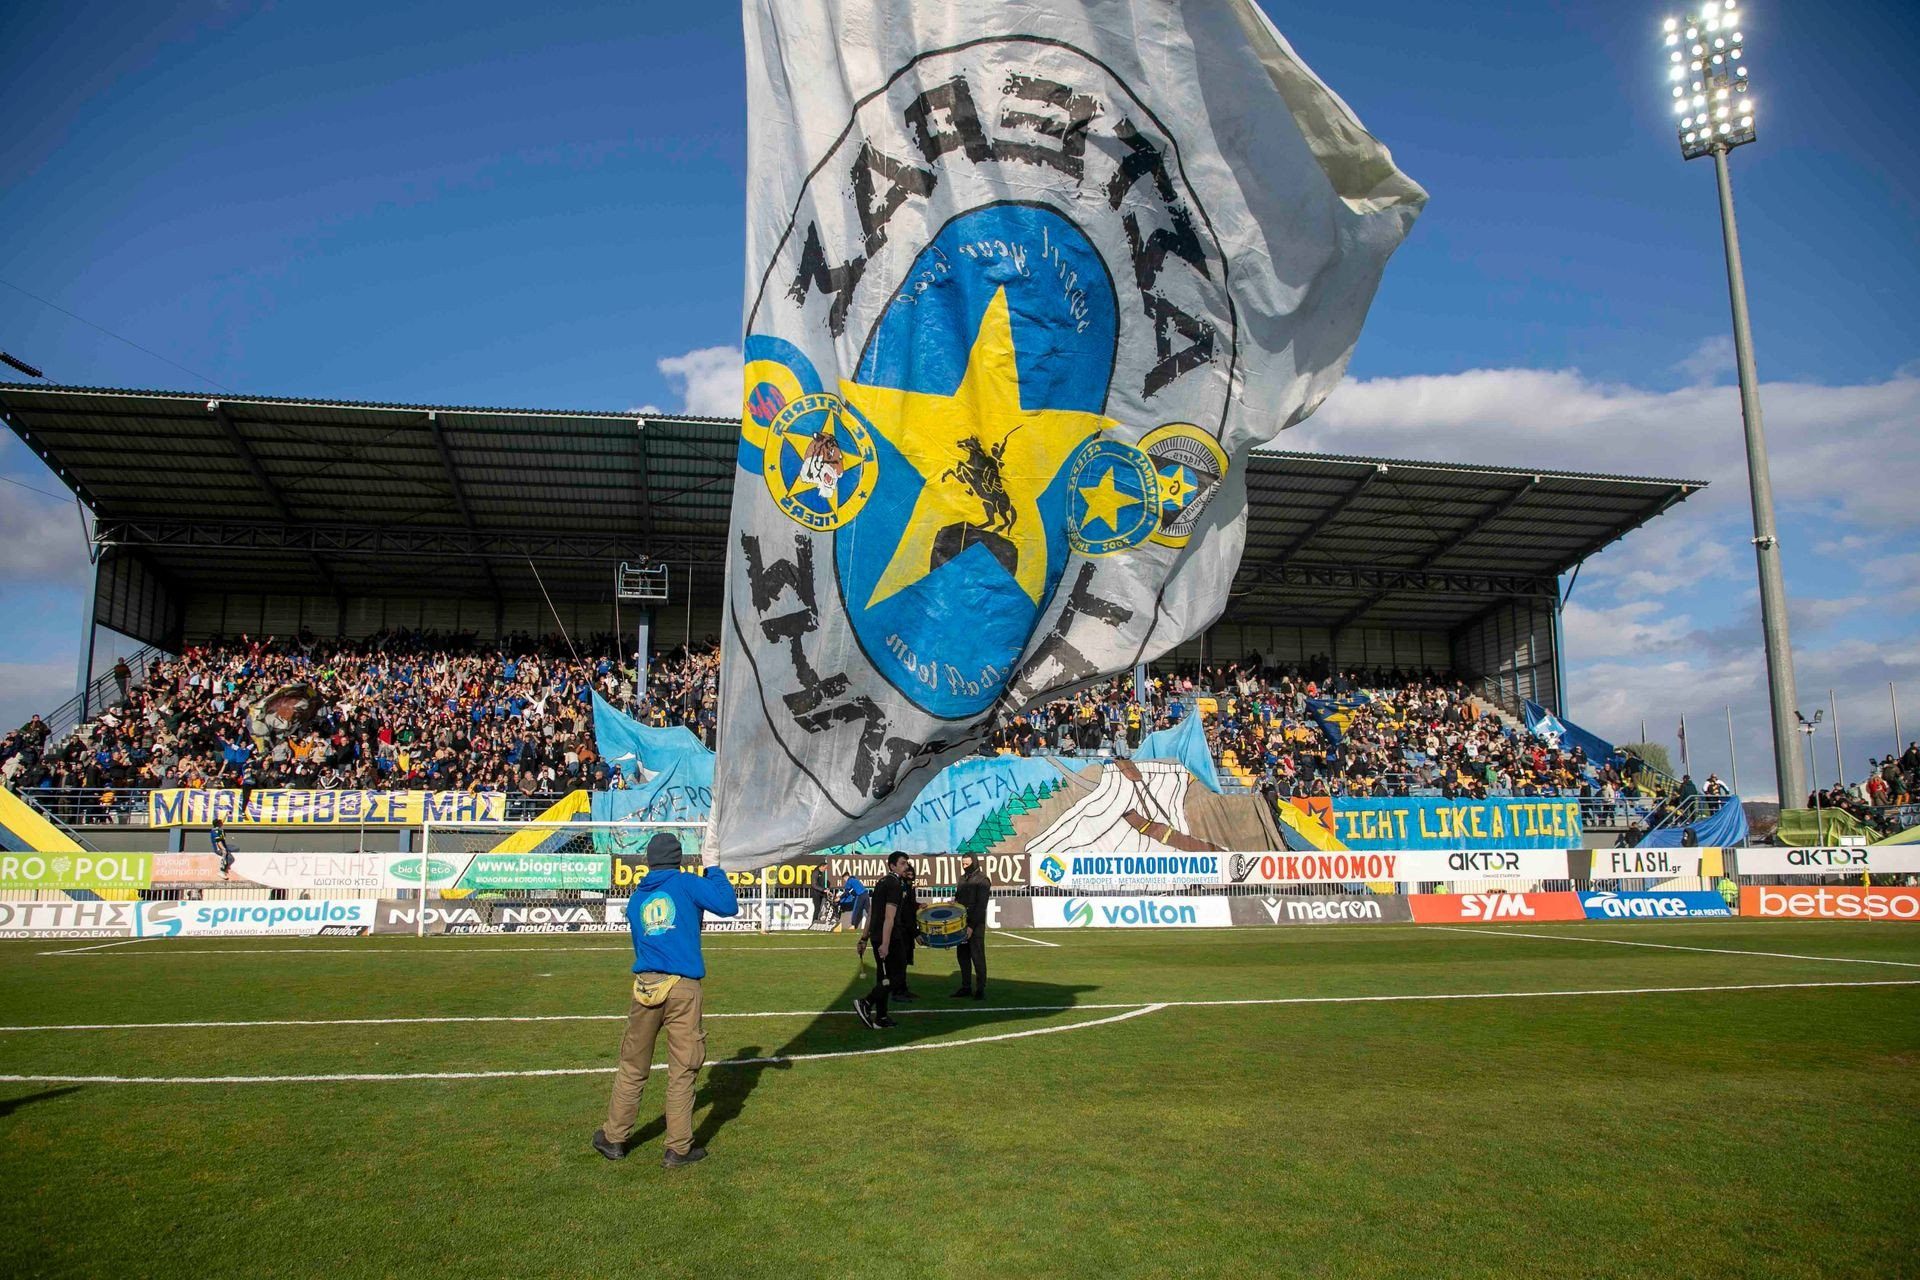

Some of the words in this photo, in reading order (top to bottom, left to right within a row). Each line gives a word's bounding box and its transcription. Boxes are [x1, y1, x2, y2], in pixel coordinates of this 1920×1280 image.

[423, 790, 502, 823] ΜΑΣ
[1333, 809, 1410, 839] FIGHT
[1419, 805, 1488, 839] LIKE
[1492, 806, 1505, 838] A
[1506, 802, 1582, 838] TIGER
[262, 855, 379, 876] ΑΡΣΕΝΗΣ
[477, 856, 604, 878] www.biogreco.gr
[832, 858, 931, 877] ΚΛΗΜΑΡΙΑ
[1072, 856, 1218, 875] ΑΠΟΣΤΟΛΟΠΟΥΛΟΣ
[1261, 855, 1396, 880] ΟΙΚΟΝΟΜΟΥ
[1612, 851, 1682, 874] FLASH.gr
[313, 877, 353, 886] ΙΔΙΩΤΙΚΟ
[356, 877, 379, 886] ΚΤΕΟ
[1072, 877, 1113, 885] ΜΕΤΑΦΟΡΕΣ
[1172, 876, 1220, 884] ΑΠΟΘΗΚΕΥΣΕΙΣ
[196, 900, 361, 928] spiropoulos
[389, 908, 482, 924] NOVA
[503, 907, 594, 924] NOVA
[1101, 900, 1198, 925] volton
[1287, 899, 1382, 920] macron
[1461, 893, 1535, 921] SYM
[1603, 897, 1689, 917] avance
[1690, 908, 1703, 916] CAR
[1703, 908, 1730, 916] RENTAL
[31, 930, 122, 938] ΣΚΥΡΟΔΕΜΑ
[321, 926, 363, 937] novibet
[451, 923, 506, 934] novibet
[515, 923, 570, 933] novibet
[706, 920, 758, 931] novibet
